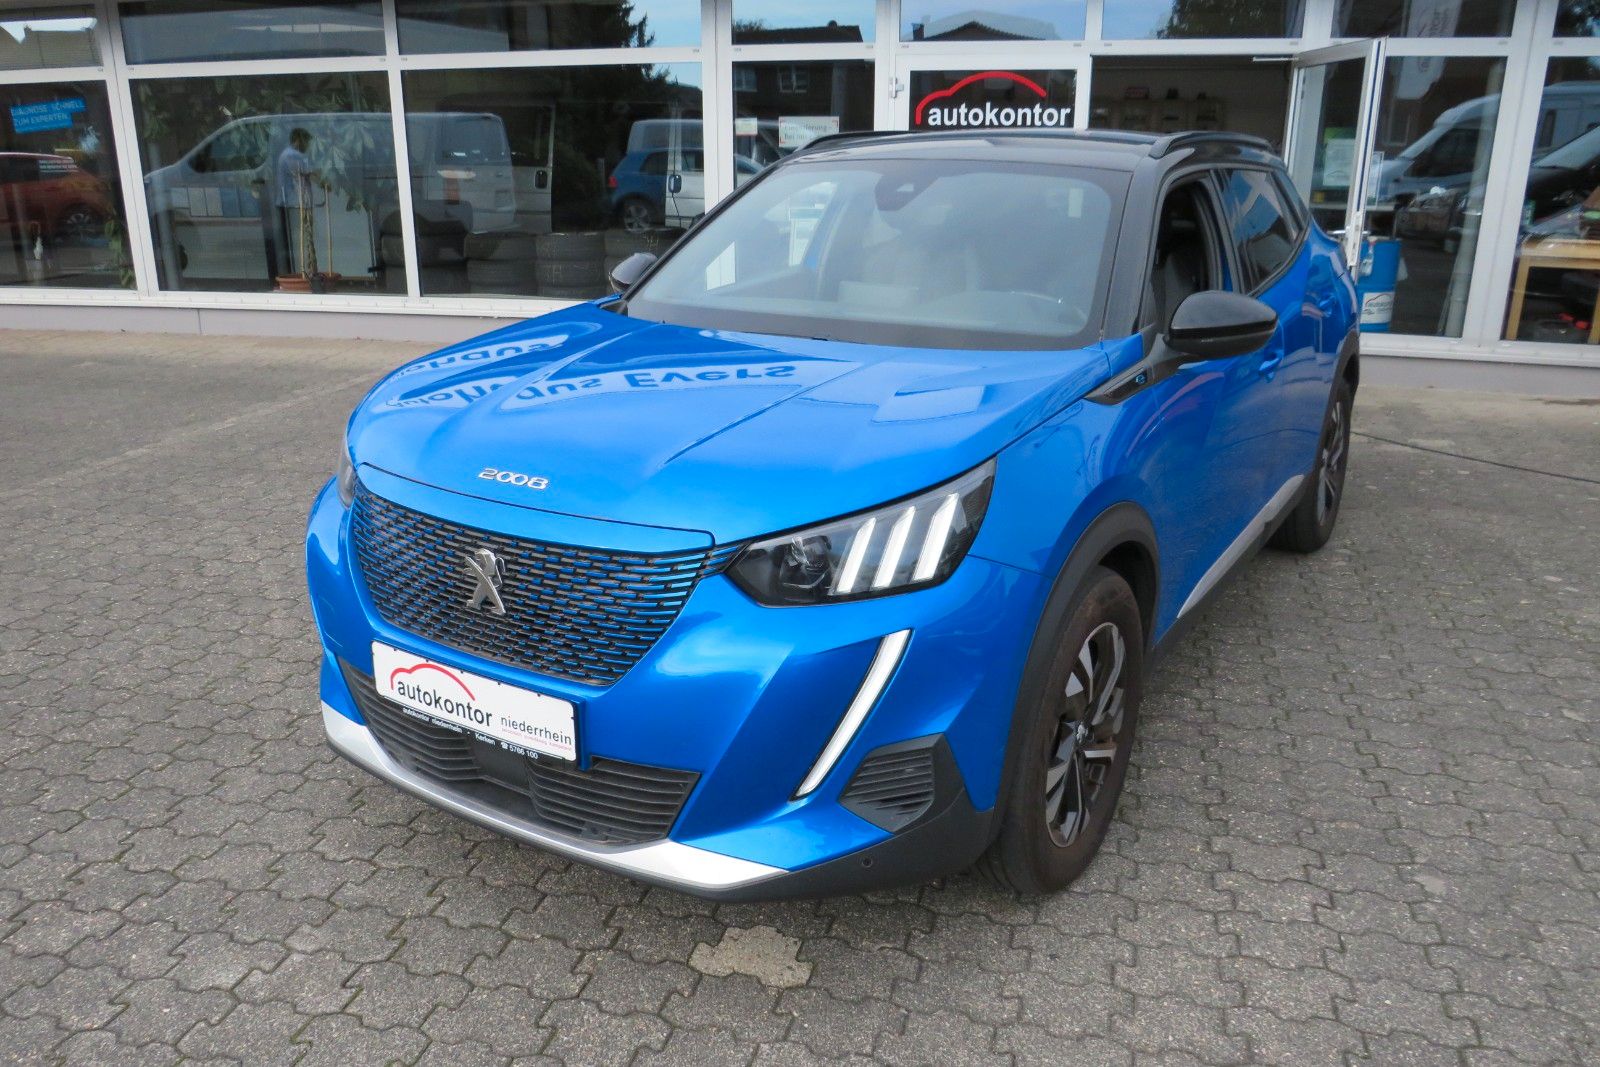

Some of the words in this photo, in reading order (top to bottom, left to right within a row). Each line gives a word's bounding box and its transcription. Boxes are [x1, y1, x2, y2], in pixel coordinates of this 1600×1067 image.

[928, 102, 1072, 126] autokontor
[478, 468, 549, 490] 2008
[397, 680, 492, 727] autokontor
[500, 714, 572, 746] niederrhein
